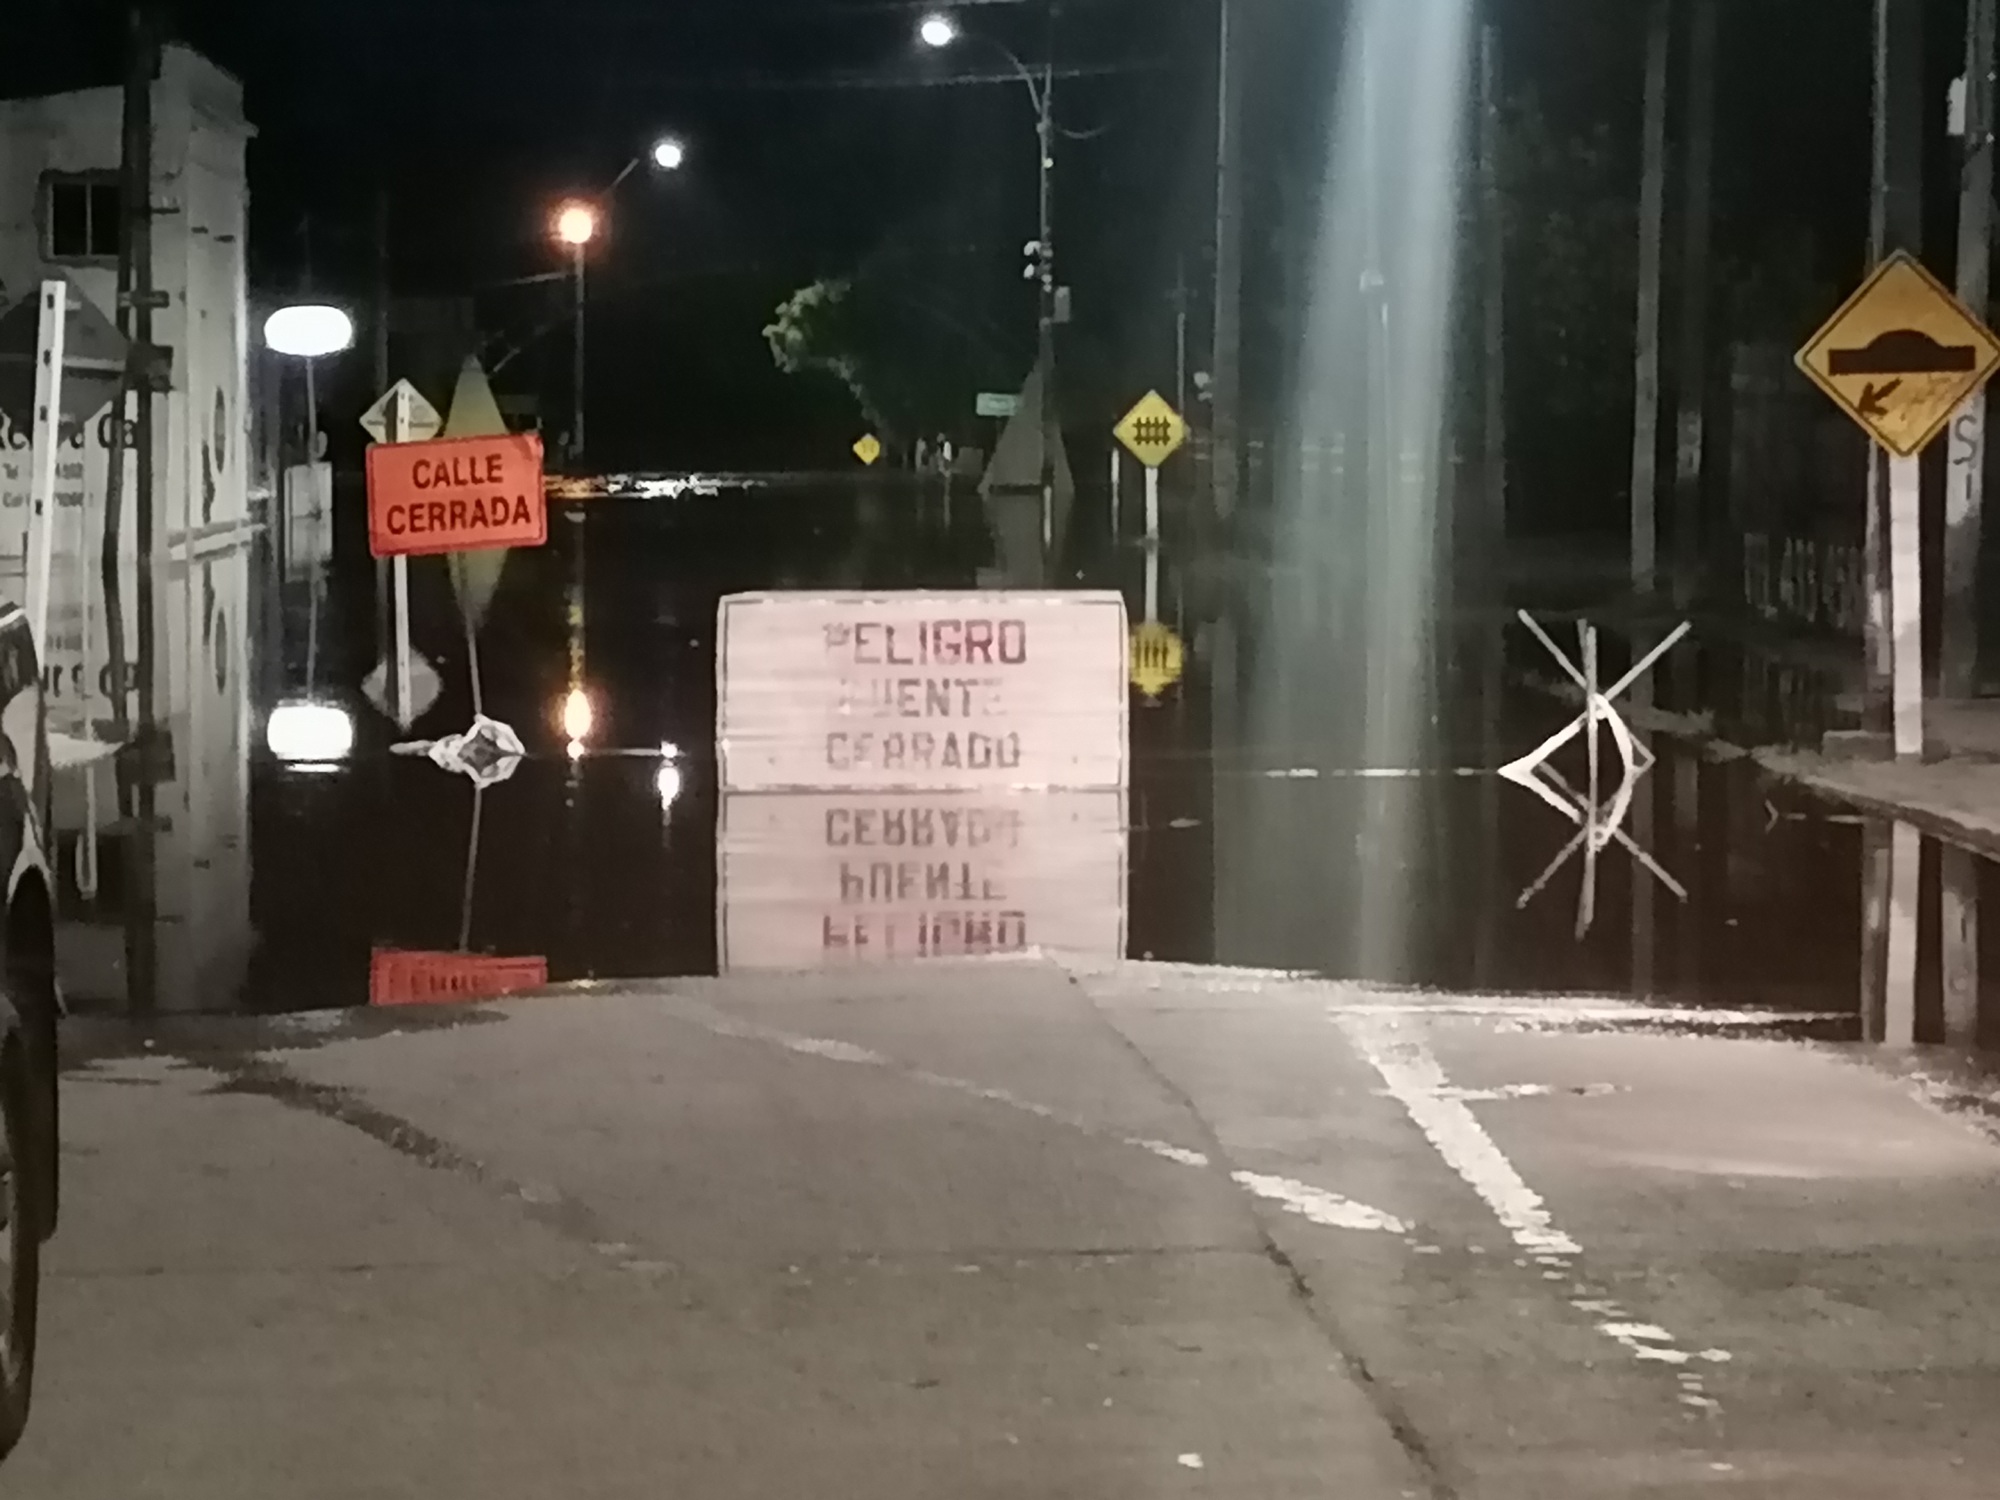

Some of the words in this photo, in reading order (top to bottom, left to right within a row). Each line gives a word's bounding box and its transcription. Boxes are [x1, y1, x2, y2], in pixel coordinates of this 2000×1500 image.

[412, 453, 503, 489] CALLE
[386, 495, 531, 535] CERRADA
[822, 618, 1027, 665] PELIGRO
[826, 731, 1020, 770] CERRADO
